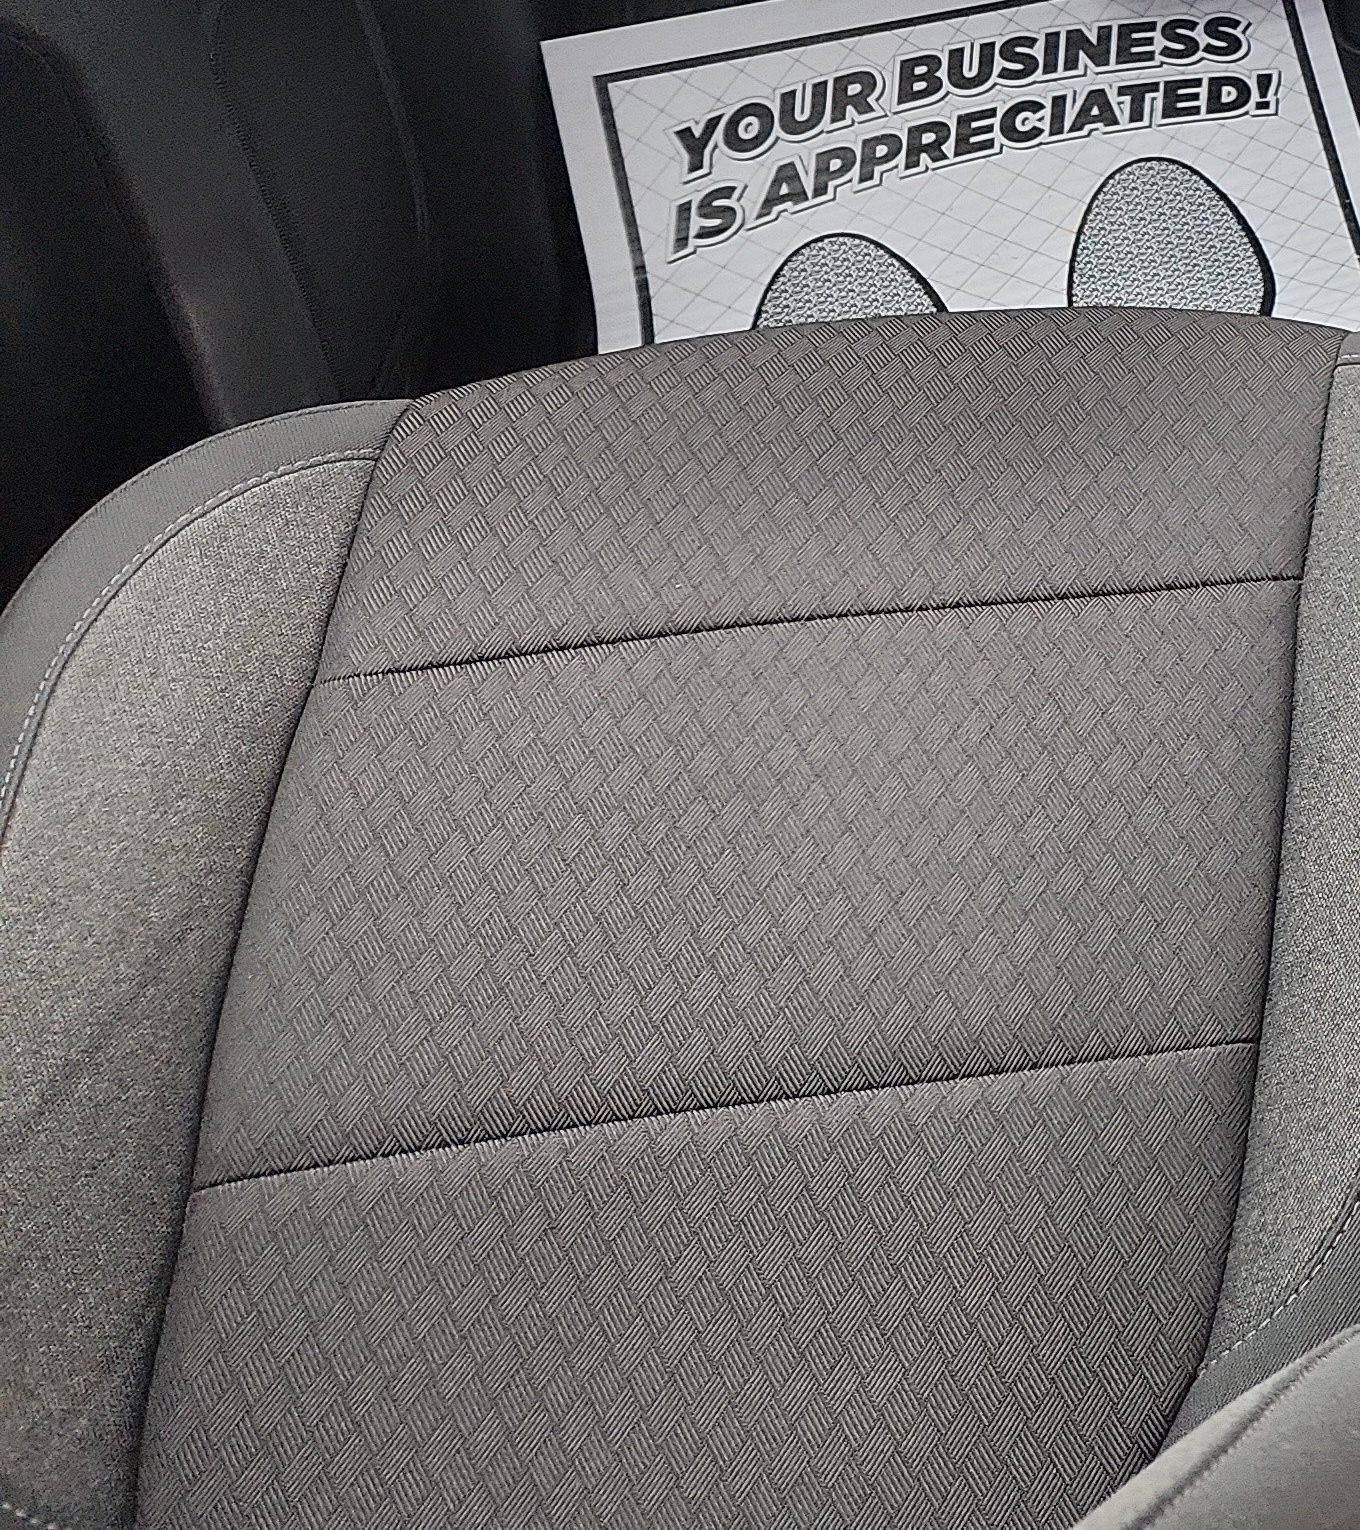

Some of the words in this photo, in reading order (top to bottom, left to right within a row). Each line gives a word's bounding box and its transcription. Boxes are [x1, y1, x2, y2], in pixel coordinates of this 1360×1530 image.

[673, 197, 743, 250] IS
[757, 73, 1276, 221] APPRECIATED!
[674, 69, 880, 174] YOUR
[898, 15, 1251, 102] BUSINESS
